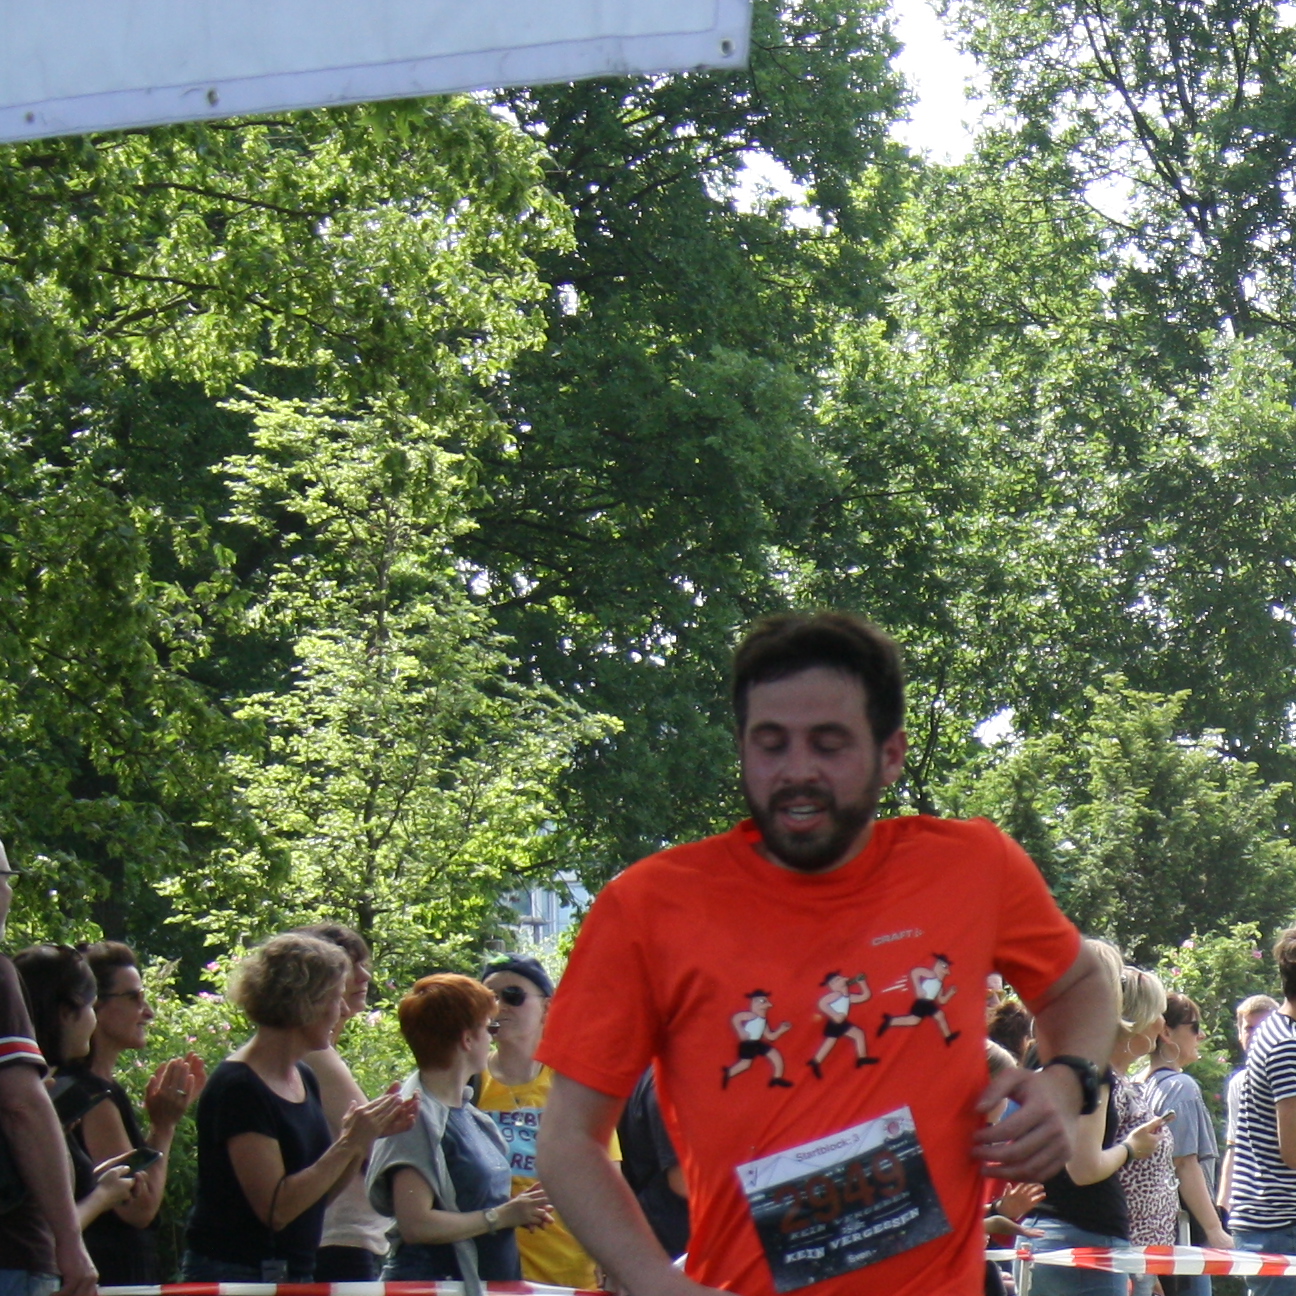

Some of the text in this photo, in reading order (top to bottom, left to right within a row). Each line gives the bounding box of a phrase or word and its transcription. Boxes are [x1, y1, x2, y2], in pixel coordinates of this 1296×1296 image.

[772, 1149, 907, 1234] 2949
[784, 1246, 826, 1264] KEIN
[829, 1207, 921, 1250] VERGESSEN
